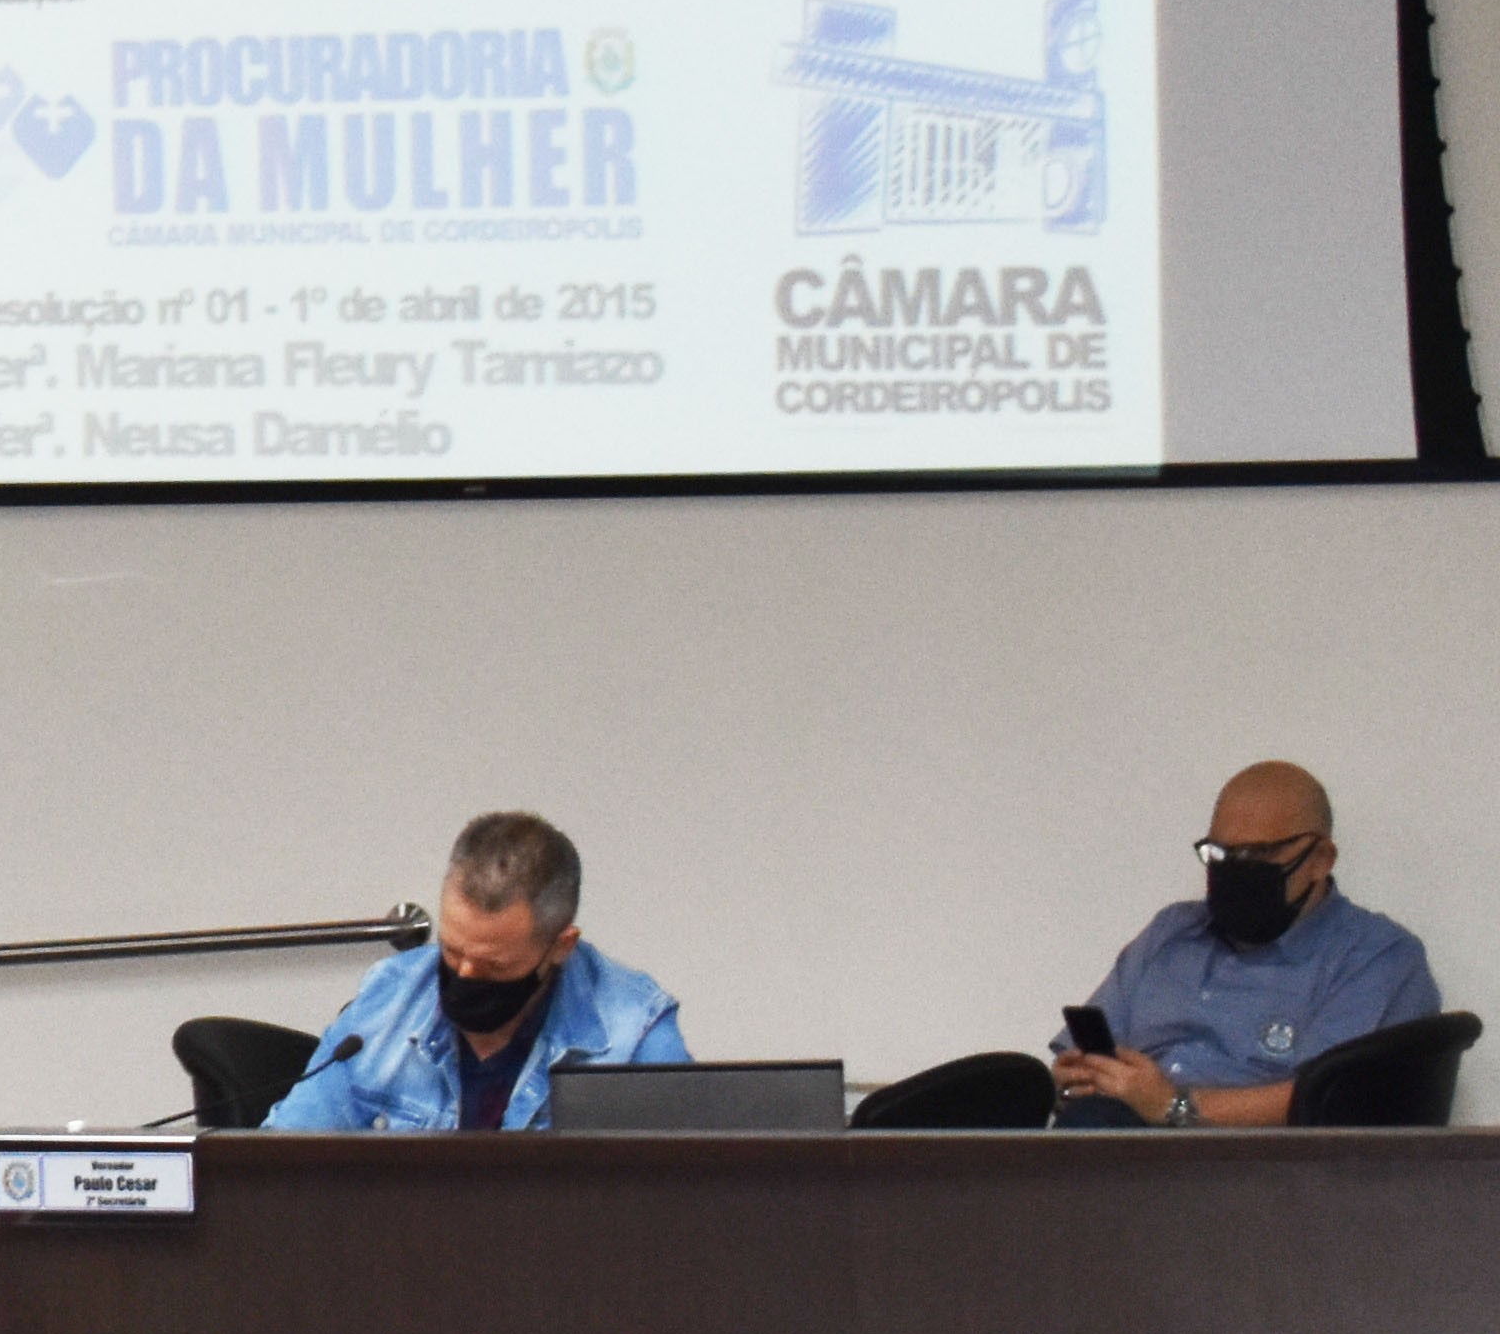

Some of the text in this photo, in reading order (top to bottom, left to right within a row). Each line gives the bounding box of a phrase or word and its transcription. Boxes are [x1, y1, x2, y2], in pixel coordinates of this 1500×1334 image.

[111, 27, 570, 107] PROCURADORIA
[112, 106, 639, 215] DA MULHER
[205, 289, 250, 325] 01
[337, 288, 386, 323] de
[399, 286, 480, 323] abril
[494, 285, 544, 322] de
[556, 282, 658, 320] 2015
[774, 253, 1106, 328] CÂMARA
[77, 342, 264, 389] Mariana
[283, 339, 435, 398] Fleury
[453, 336, 666, 388] Tamiazo
[775, 332, 1106, 371] MUNICIPAL DE
[775, 368, 1111, 414] CORDEIRÓPOLIS
[82, 414, 236, 458] Neusa
[254, 408, 451, 457] Damélio
[74, 1175, 158, 1191] Paulo Cesar
